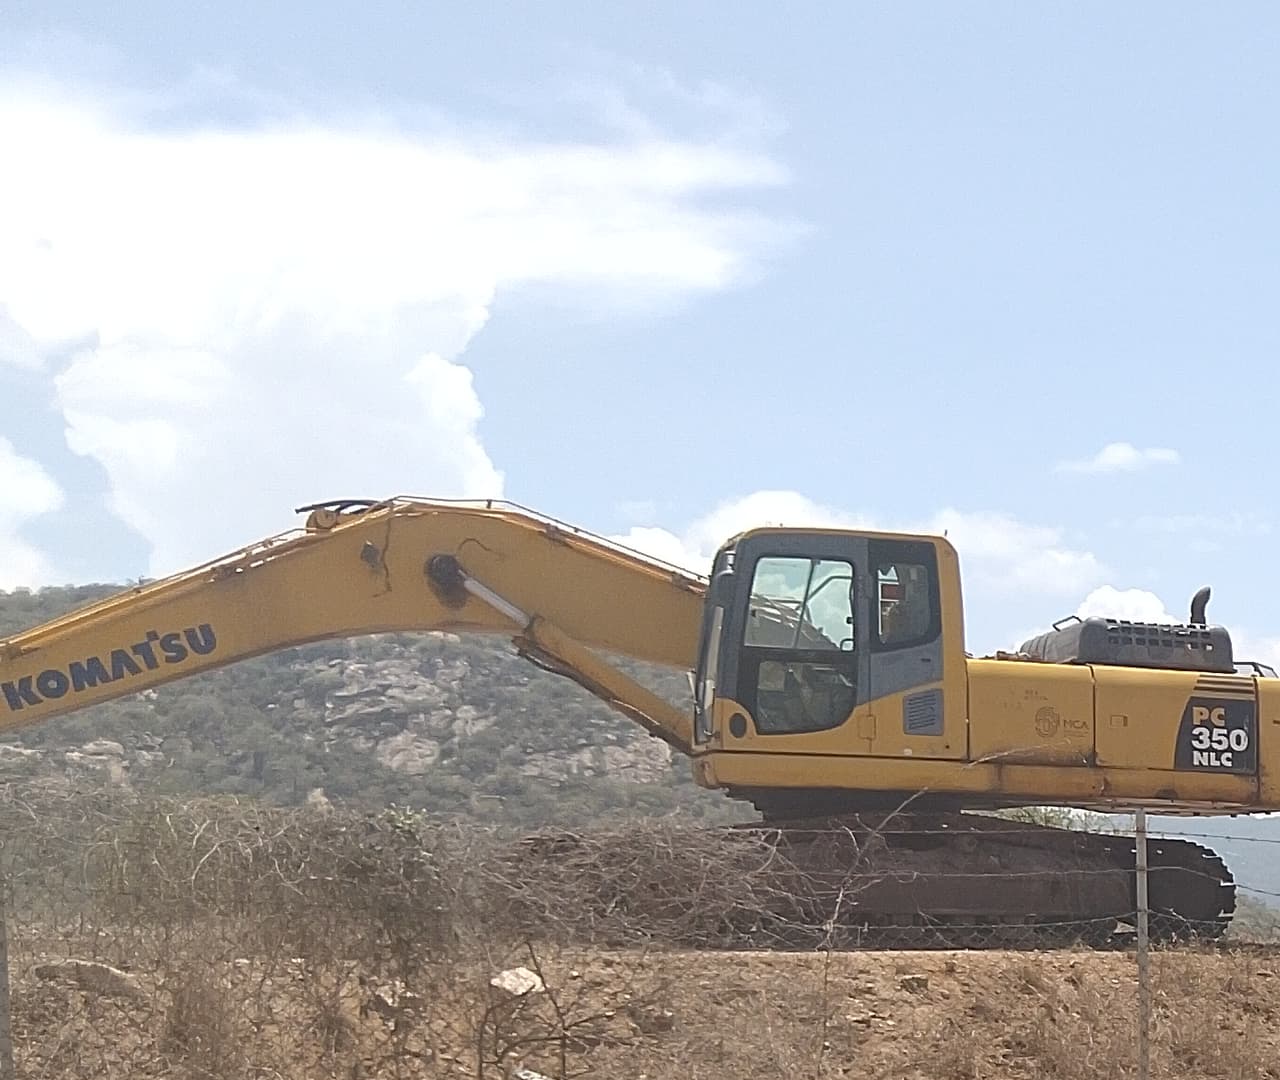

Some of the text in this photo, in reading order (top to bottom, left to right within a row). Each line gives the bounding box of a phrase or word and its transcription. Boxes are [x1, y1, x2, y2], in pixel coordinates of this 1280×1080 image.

[1, 623, 217, 711] KOMATSU
[1063, 719, 1090, 730] MCA
[1192, 706, 1226, 726] PC
[1191, 726, 1249, 752] 350
[1192, 751, 1233, 767] NLC
